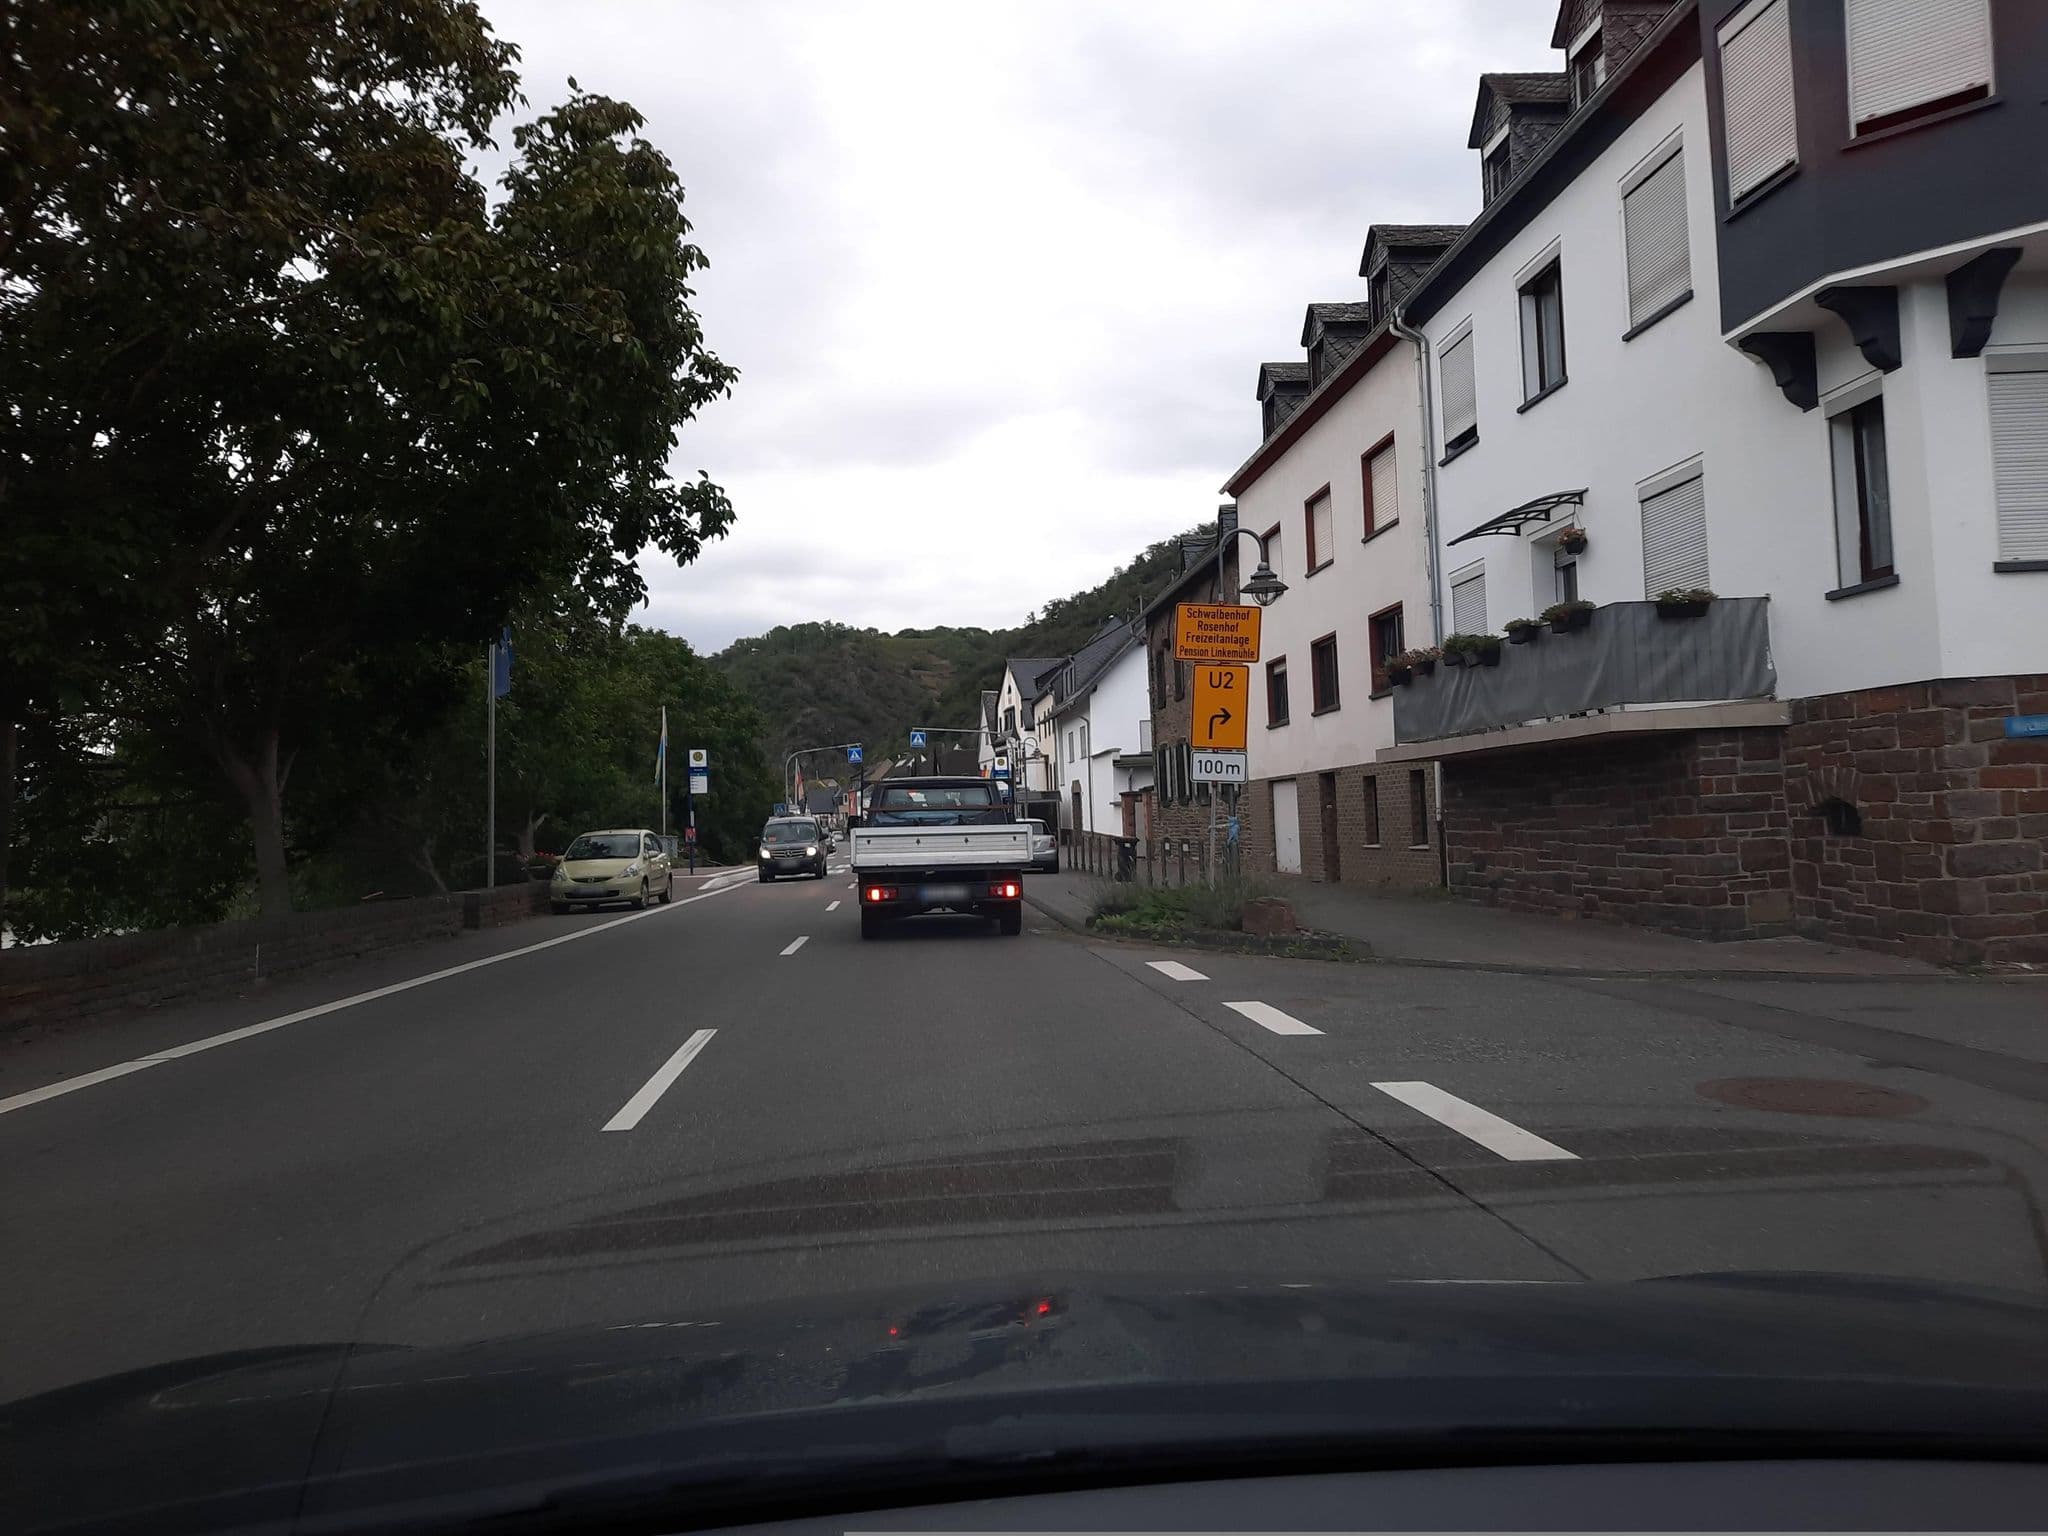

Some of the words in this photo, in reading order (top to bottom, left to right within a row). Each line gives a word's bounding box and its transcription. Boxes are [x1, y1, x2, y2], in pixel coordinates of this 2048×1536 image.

[1187, 608, 1250, 620] Schwalbenhof
[1197, 621, 1239, 632] Rosenhof
[1186, 632, 1249, 647] Freizeitanlage
[1180, 645, 1209, 657] Pension
[1211, 647, 1255, 659] Linkemühle
[1209, 672, 1234, 689] U2
